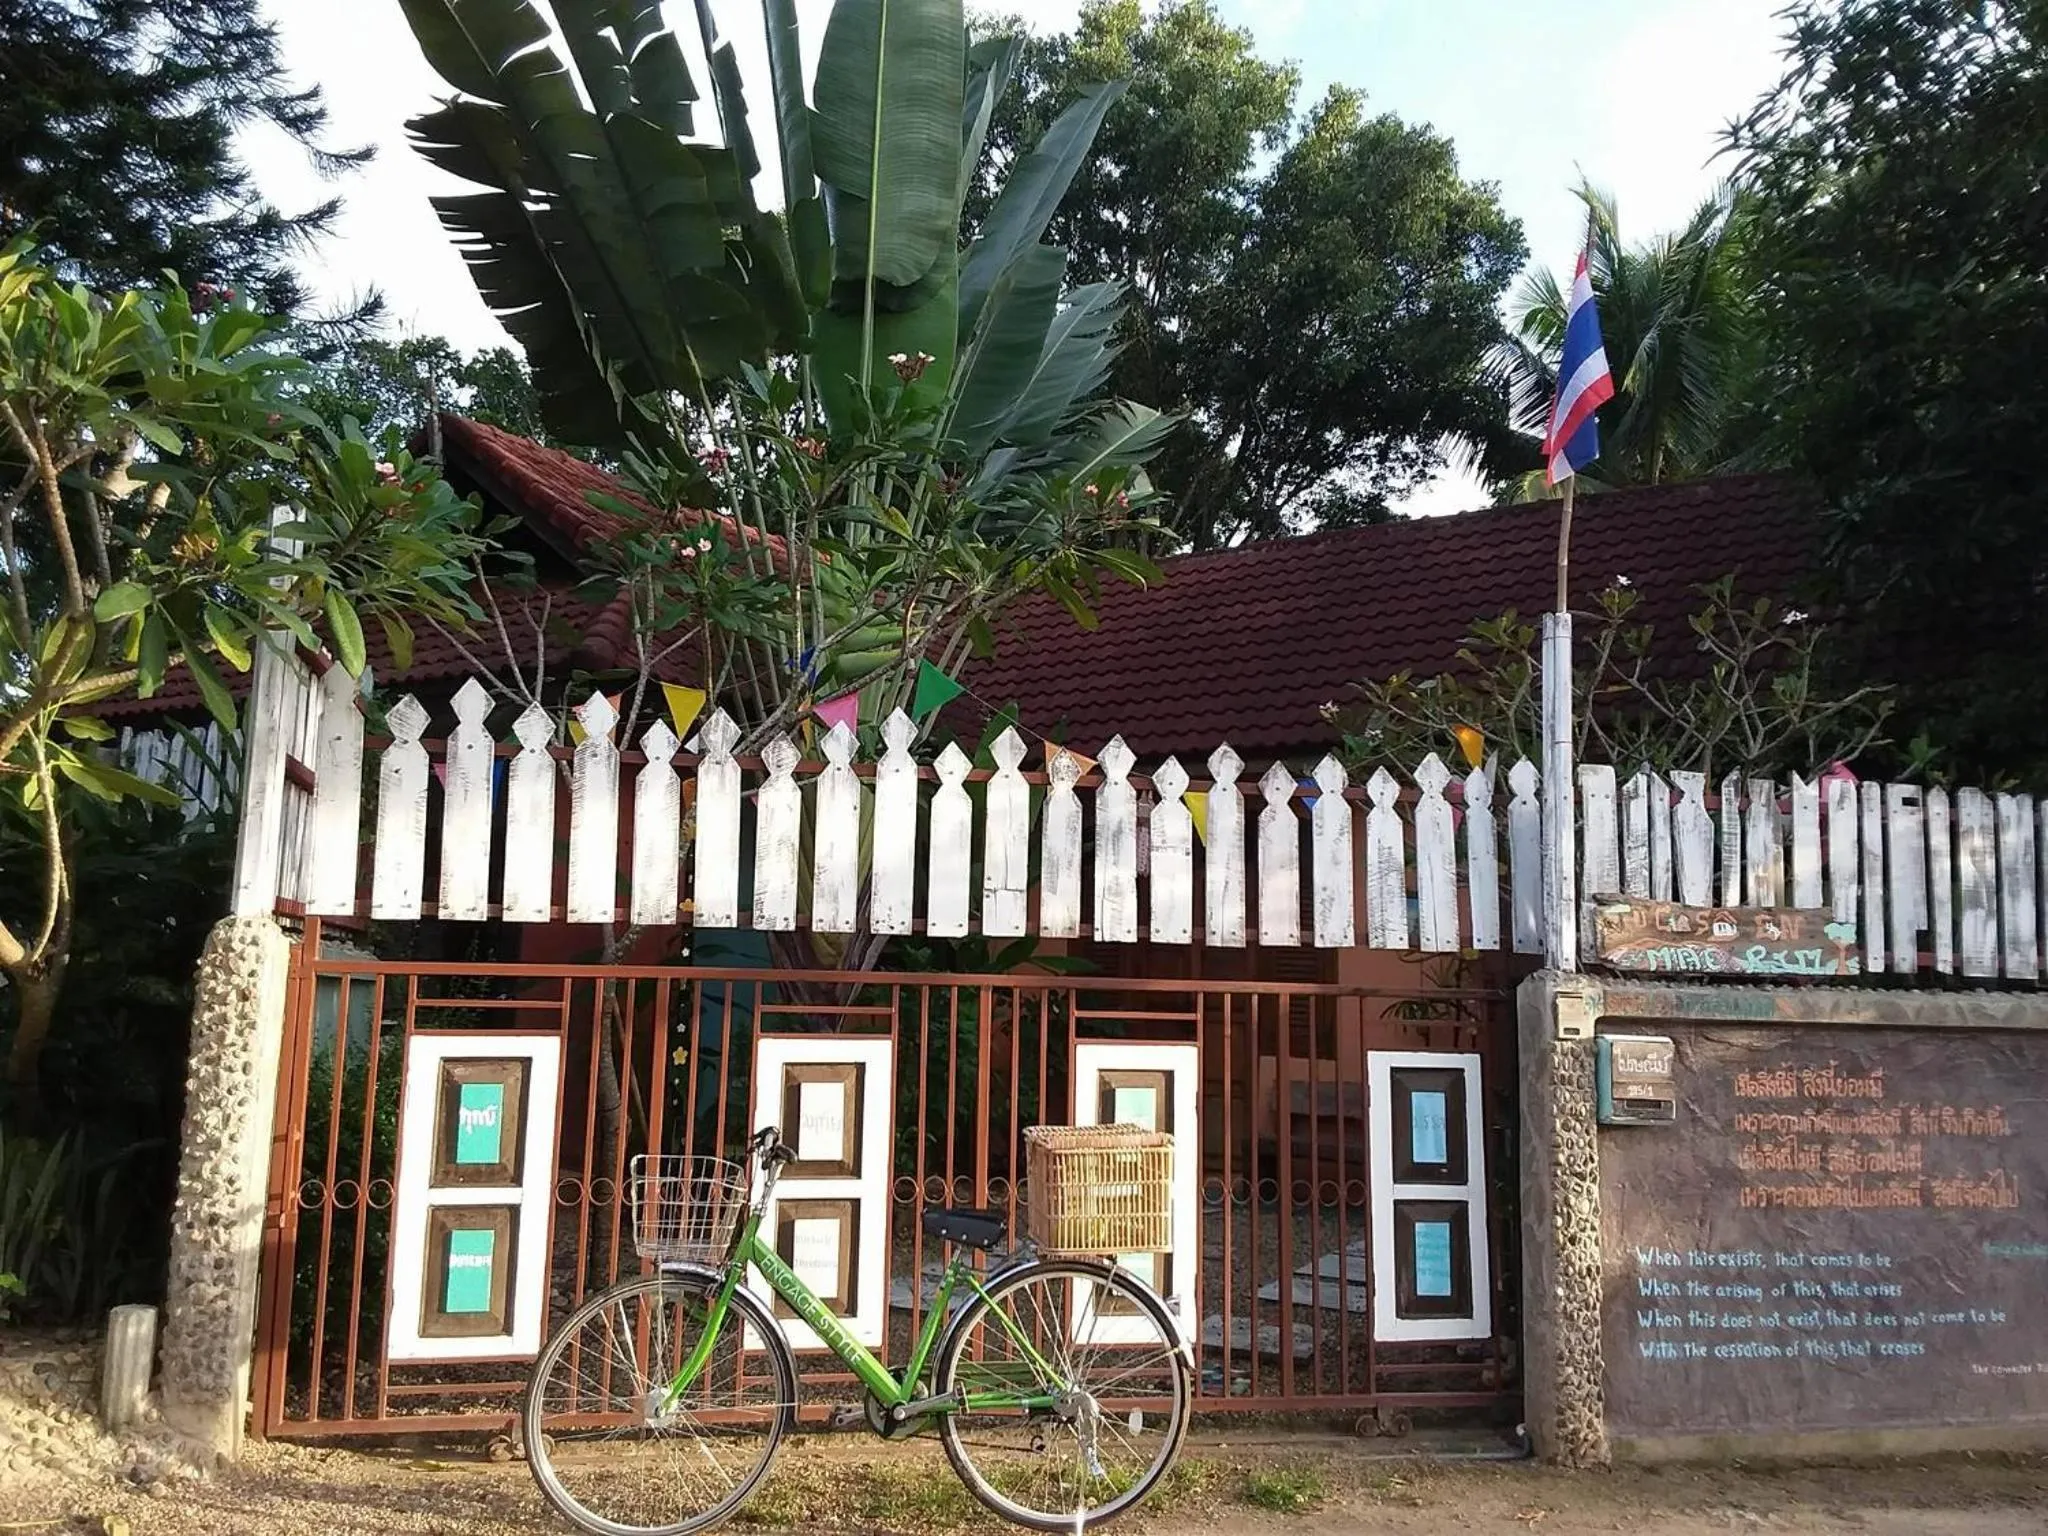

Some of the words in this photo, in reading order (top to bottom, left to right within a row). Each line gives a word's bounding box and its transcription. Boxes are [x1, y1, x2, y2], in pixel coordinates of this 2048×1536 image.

[1635, 1246, 1682, 1266] When
[1688, 1249, 1716, 1266] this
[1775, 1251, 1804, 1267] that
[1811, 1255, 1853, 1267] comes
[1859, 1253, 1872, 1266] to
[1876, 1253, 1892, 1268] be
[1638, 1276, 1681, 1297] When
[1686, 1279, 1711, 1297] the
[1715, 1284, 1763, 1303] arising
[1771, 1283, 1787, 1297] of
[1829, 1281, 1860, 1297] that
[1863, 1284, 1903, 1297] arises
[761, 1254, 818, 1319] ENGAGE
[816, 1314, 863, 1367] STYLE
[1636, 1308, 1682, 1328] When
[1688, 1309, 1716, 1328] this
[1721, 1312, 1753, 1328] does
[1759, 1311, 1781, 1327] not
[1826, 1309, 1858, 1327] that
[1863, 1312, 1898, 1327] does
[1904, 1311, 1925, 1327] not
[1931, 1311, 1966, 1324] come
[1969, 1308, 1987, 1322] to
[1990, 1308, 2007, 1322] be
[1639, 1341, 1677, 1358] With
[1684, 1341, 1708, 1357] the
[1714, 1341, 1782, 1358] cessation
[1785, 1340, 1800, 1357] of
[1840, 1340, 1872, 1357] that
[1880, 1343, 1926, 1356] ceases
